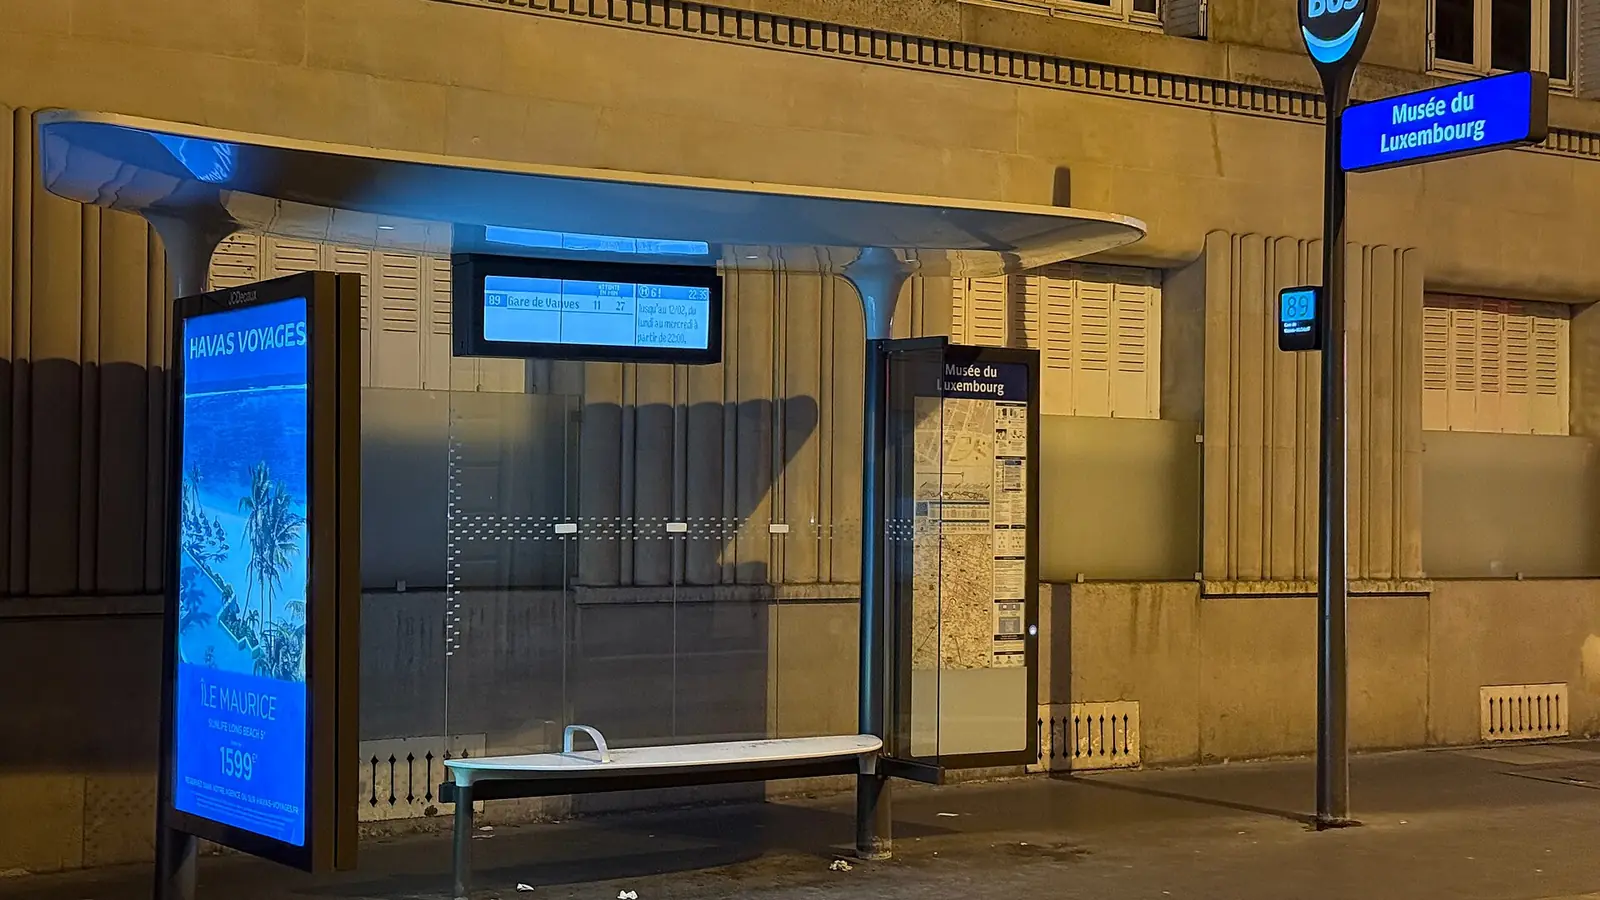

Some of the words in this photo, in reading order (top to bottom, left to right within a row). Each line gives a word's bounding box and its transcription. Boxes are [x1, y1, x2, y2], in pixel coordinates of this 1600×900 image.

[1392, 97, 1446, 125] Musée
[1451, 91, 1475, 114] du
[1380, 119, 1487, 153] Luxembourg
[489, 294, 501, 306] 89
[508, 296, 530, 308] Gare
[532, 297, 544, 309] de
[546, 298, 580, 310] Vanves
[593, 300, 601, 311] 11
[616, 302, 626, 312] 27
[1287, 296, 1309, 318] 89
[190, 331, 235, 360] HAVAS
[238, 321, 306, 353] VOYAGES
[945, 364, 981, 377] Musée
[983, 365, 997, 378] du
[937, 379, 1005, 396] Luxembourg
[200, 677, 217, 709] ÎLE
[220, 687, 277, 720] MAURICE
[228, 723, 242, 735] LONG
[242, 726, 260, 739] BEACH
